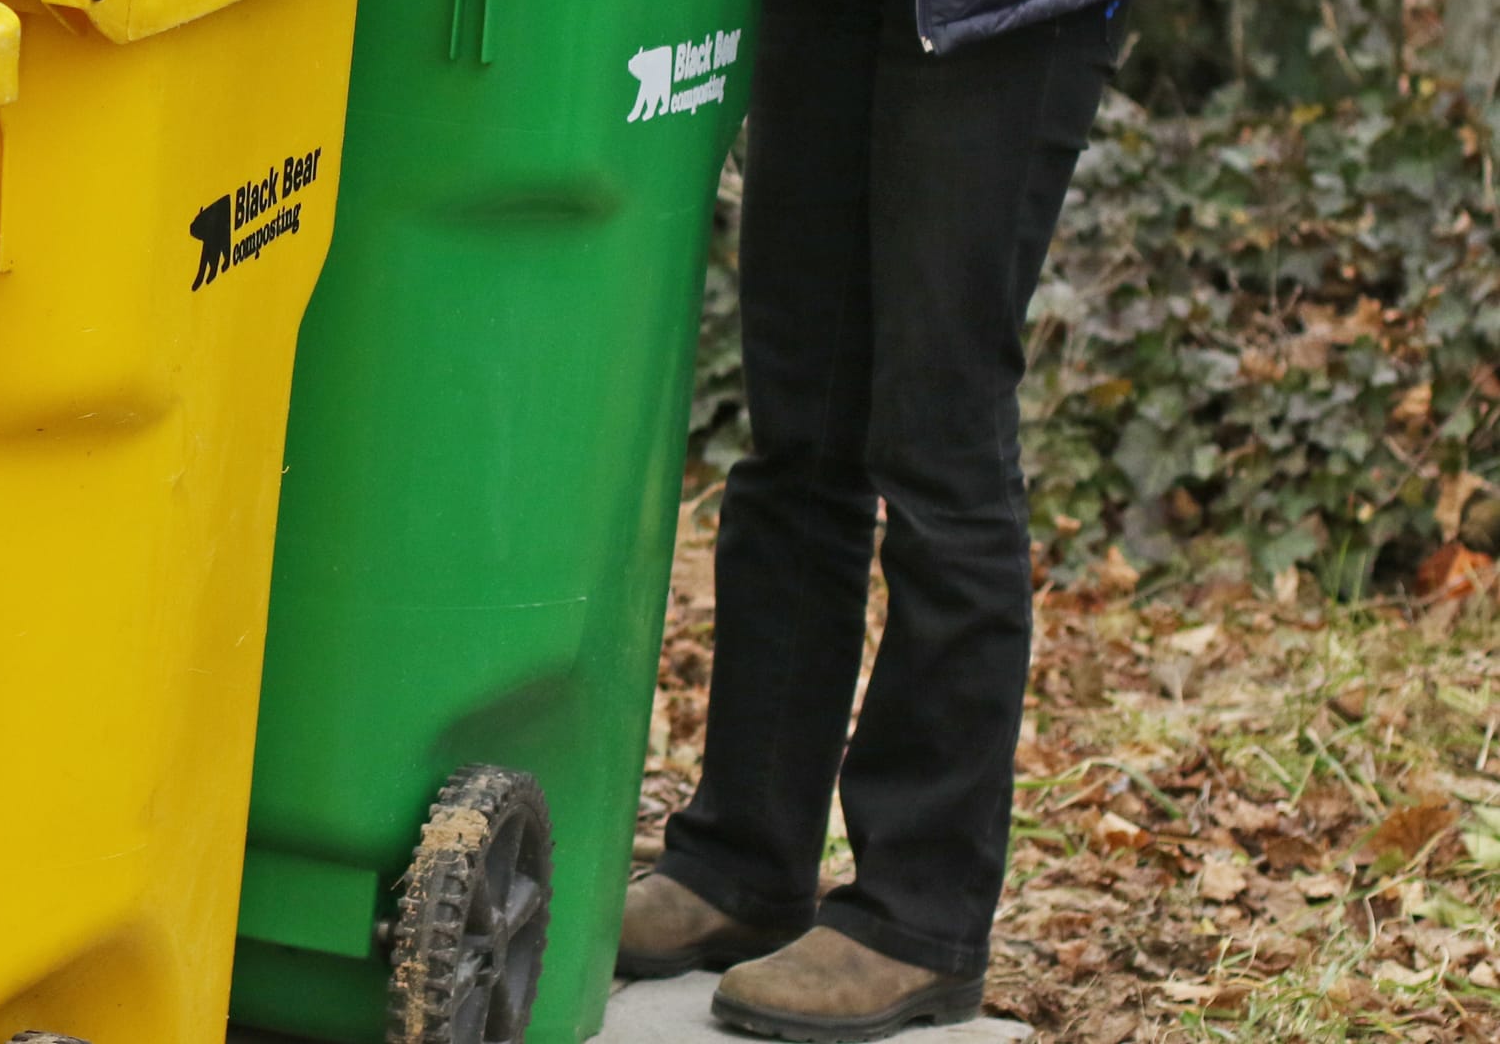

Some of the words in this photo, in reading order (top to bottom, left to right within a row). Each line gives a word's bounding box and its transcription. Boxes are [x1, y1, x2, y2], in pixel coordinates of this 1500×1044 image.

[234, 166, 279, 232] Black
[282, 146, 322, 200] Bear
[232, 202, 302, 267] composting
